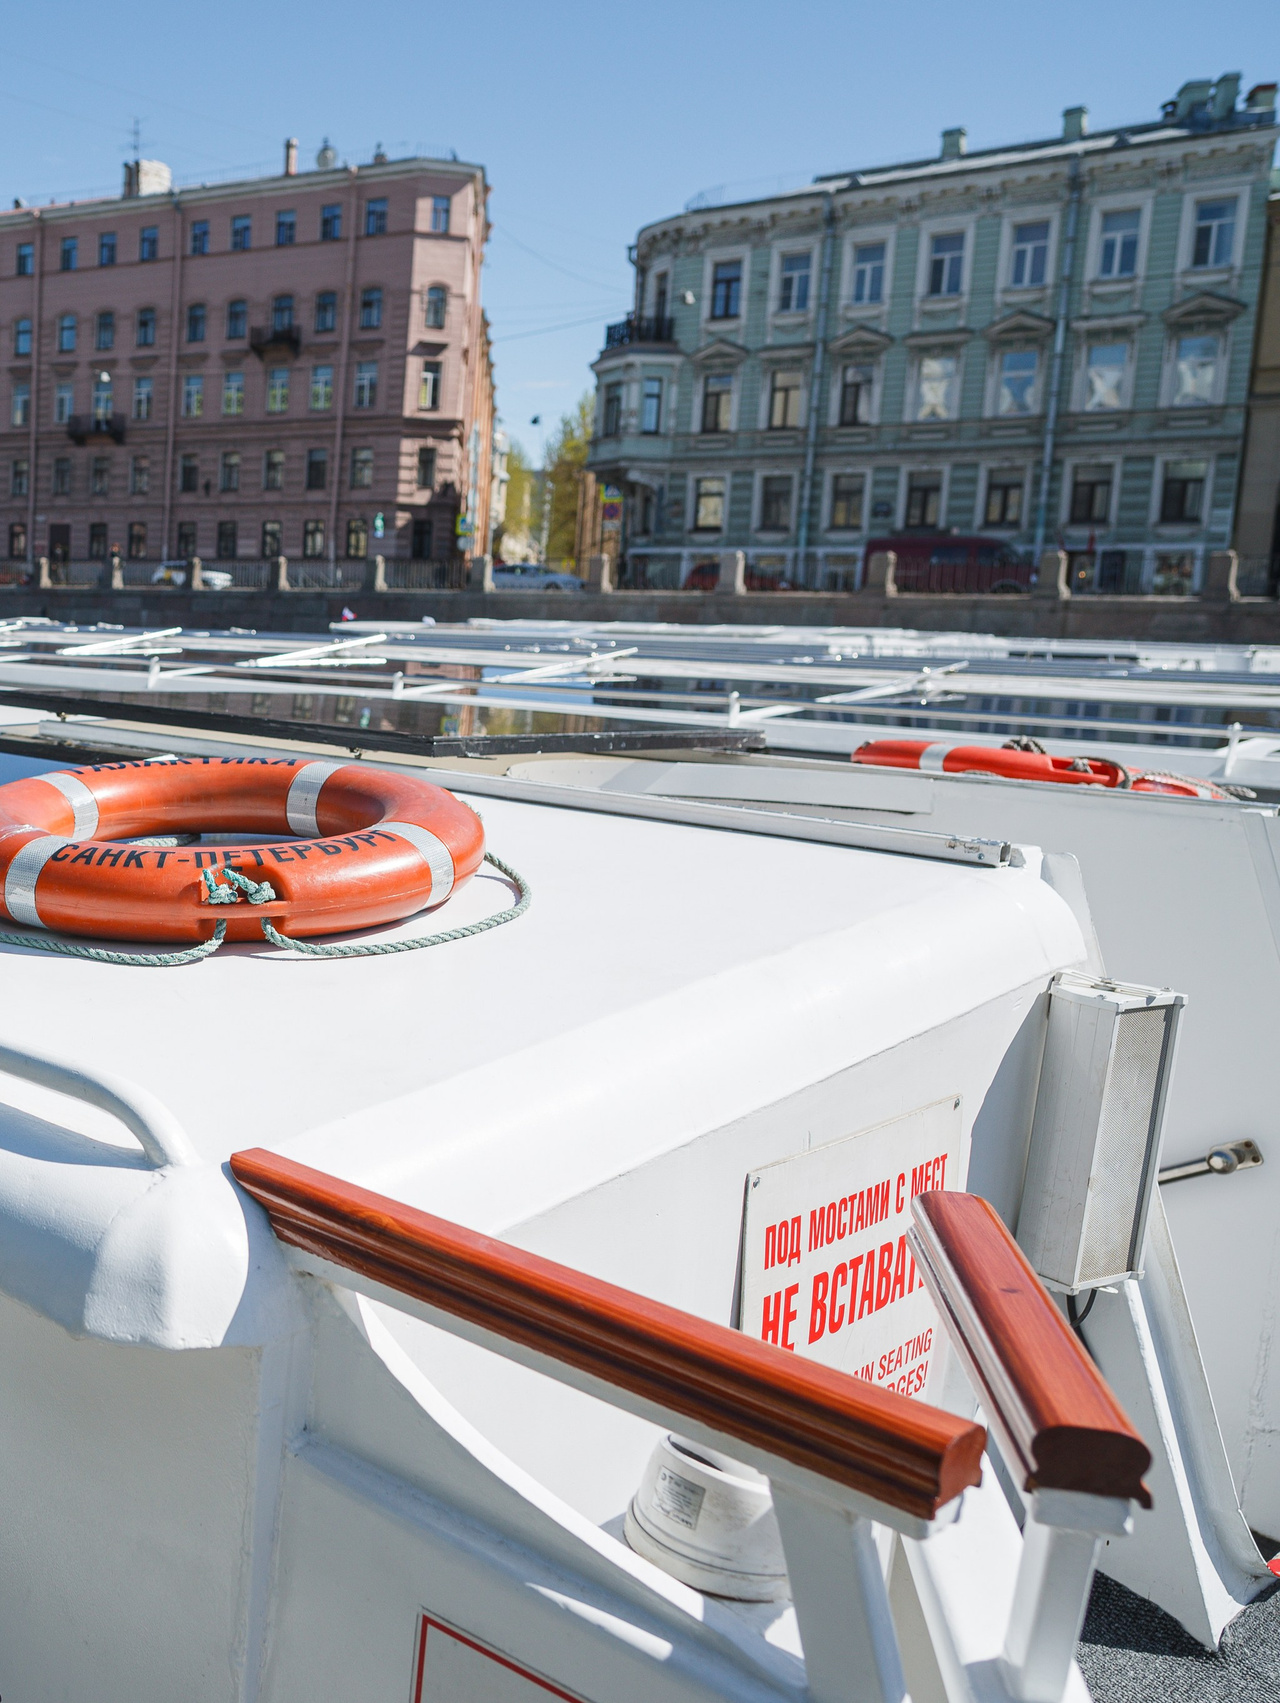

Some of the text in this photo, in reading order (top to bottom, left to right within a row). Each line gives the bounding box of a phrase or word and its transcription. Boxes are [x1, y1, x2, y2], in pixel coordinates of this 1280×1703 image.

[51, 829, 396, 872] САНКТ-ПЕТЕРБУРГ
[764, 1214, 802, 1270] ПОД
[808, 1179, 891, 1253] МОСТАМИ
[896, 1172, 906, 1214] С
[761, 1234, 925, 1352] НЕ ВСТАВА
[877, 1328, 933, 1381] SEATING
